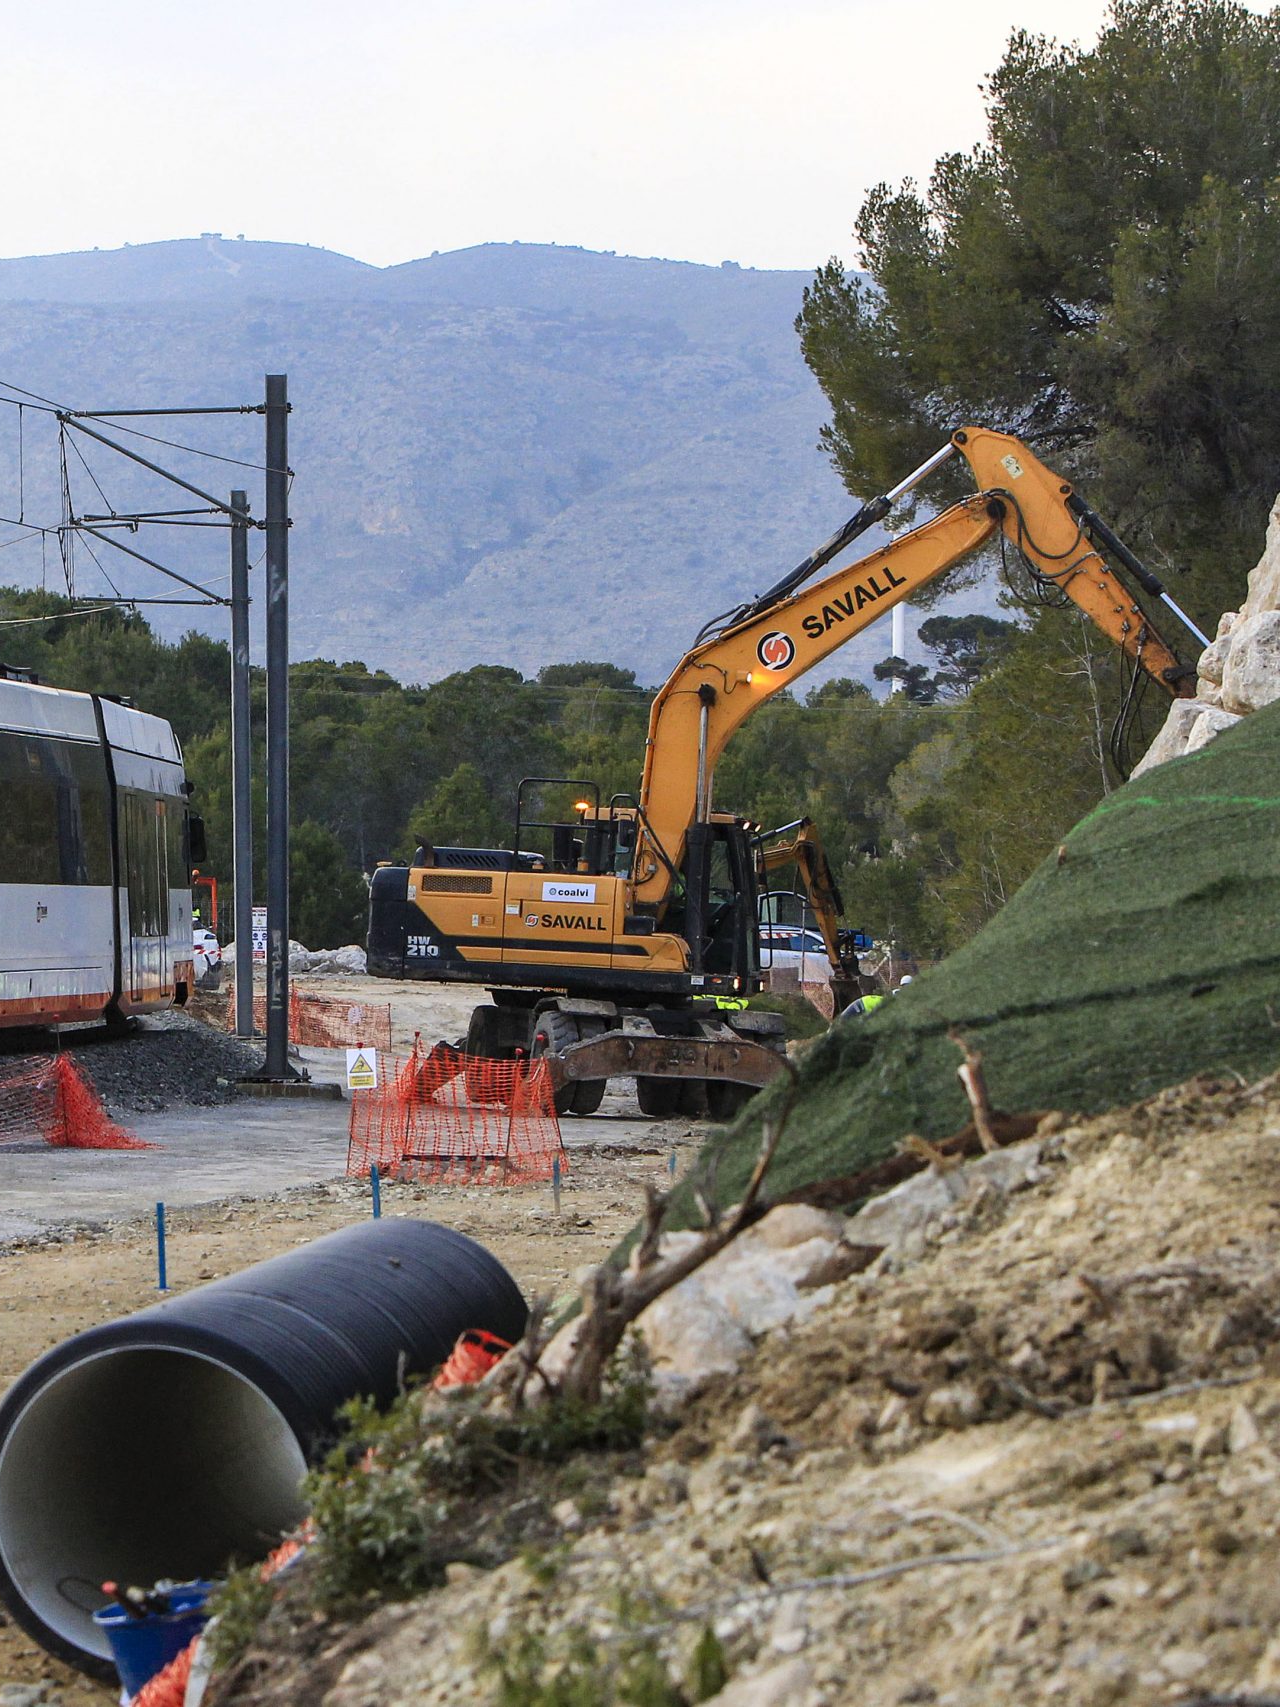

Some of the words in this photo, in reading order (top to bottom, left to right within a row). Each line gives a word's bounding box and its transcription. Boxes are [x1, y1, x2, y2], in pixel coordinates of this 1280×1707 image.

[801, 567, 908, 639] SAVALL
[557, 888, 589, 897] coalvi
[541, 914, 607, 931] SAVALL
[407, 935, 431, 945] HW
[407, 945, 439, 956] 210
